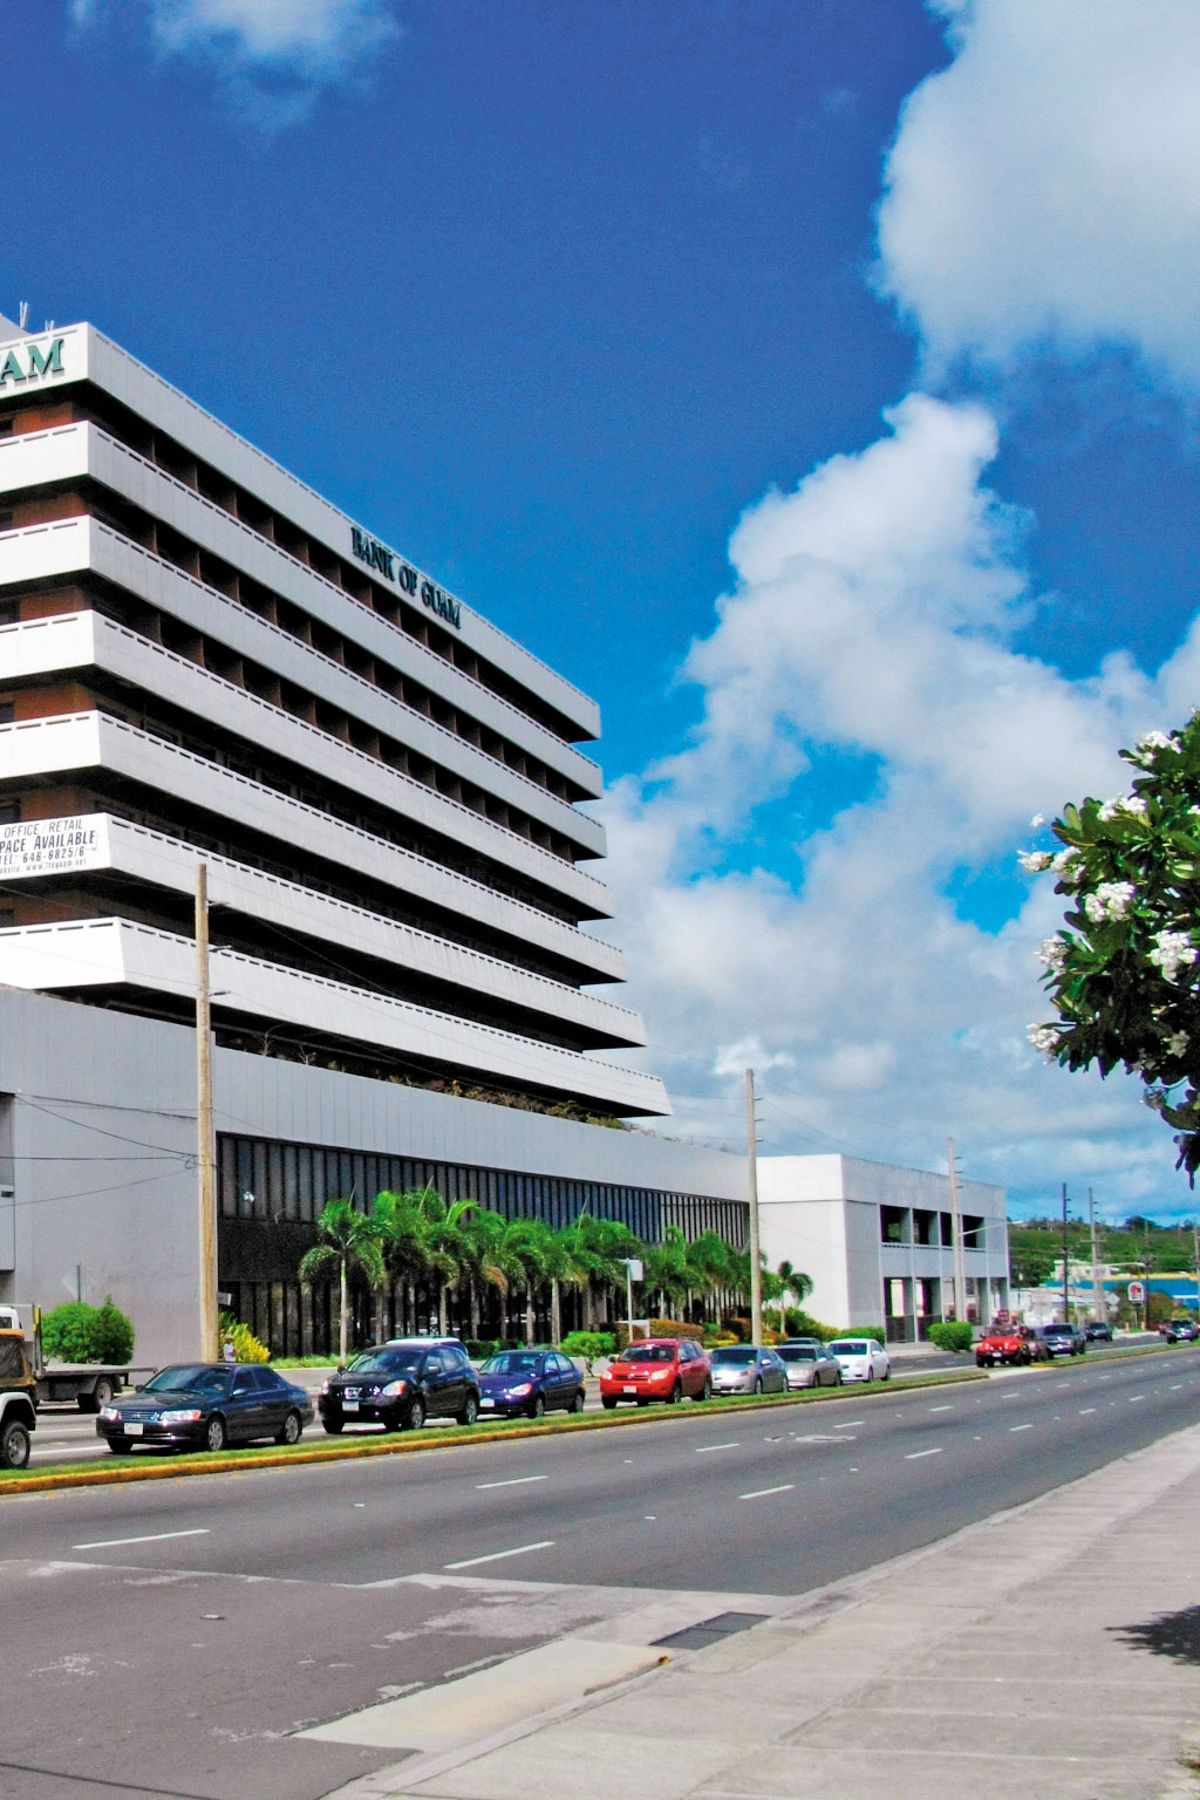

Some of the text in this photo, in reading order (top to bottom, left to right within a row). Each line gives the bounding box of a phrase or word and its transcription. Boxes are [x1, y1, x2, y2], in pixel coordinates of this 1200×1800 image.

[351, 527, 461, 630] BANK OF GUAM
[4, 818, 84, 839] OFFICE RETAIL
[34, 830, 96, 850] AVAILABLE
